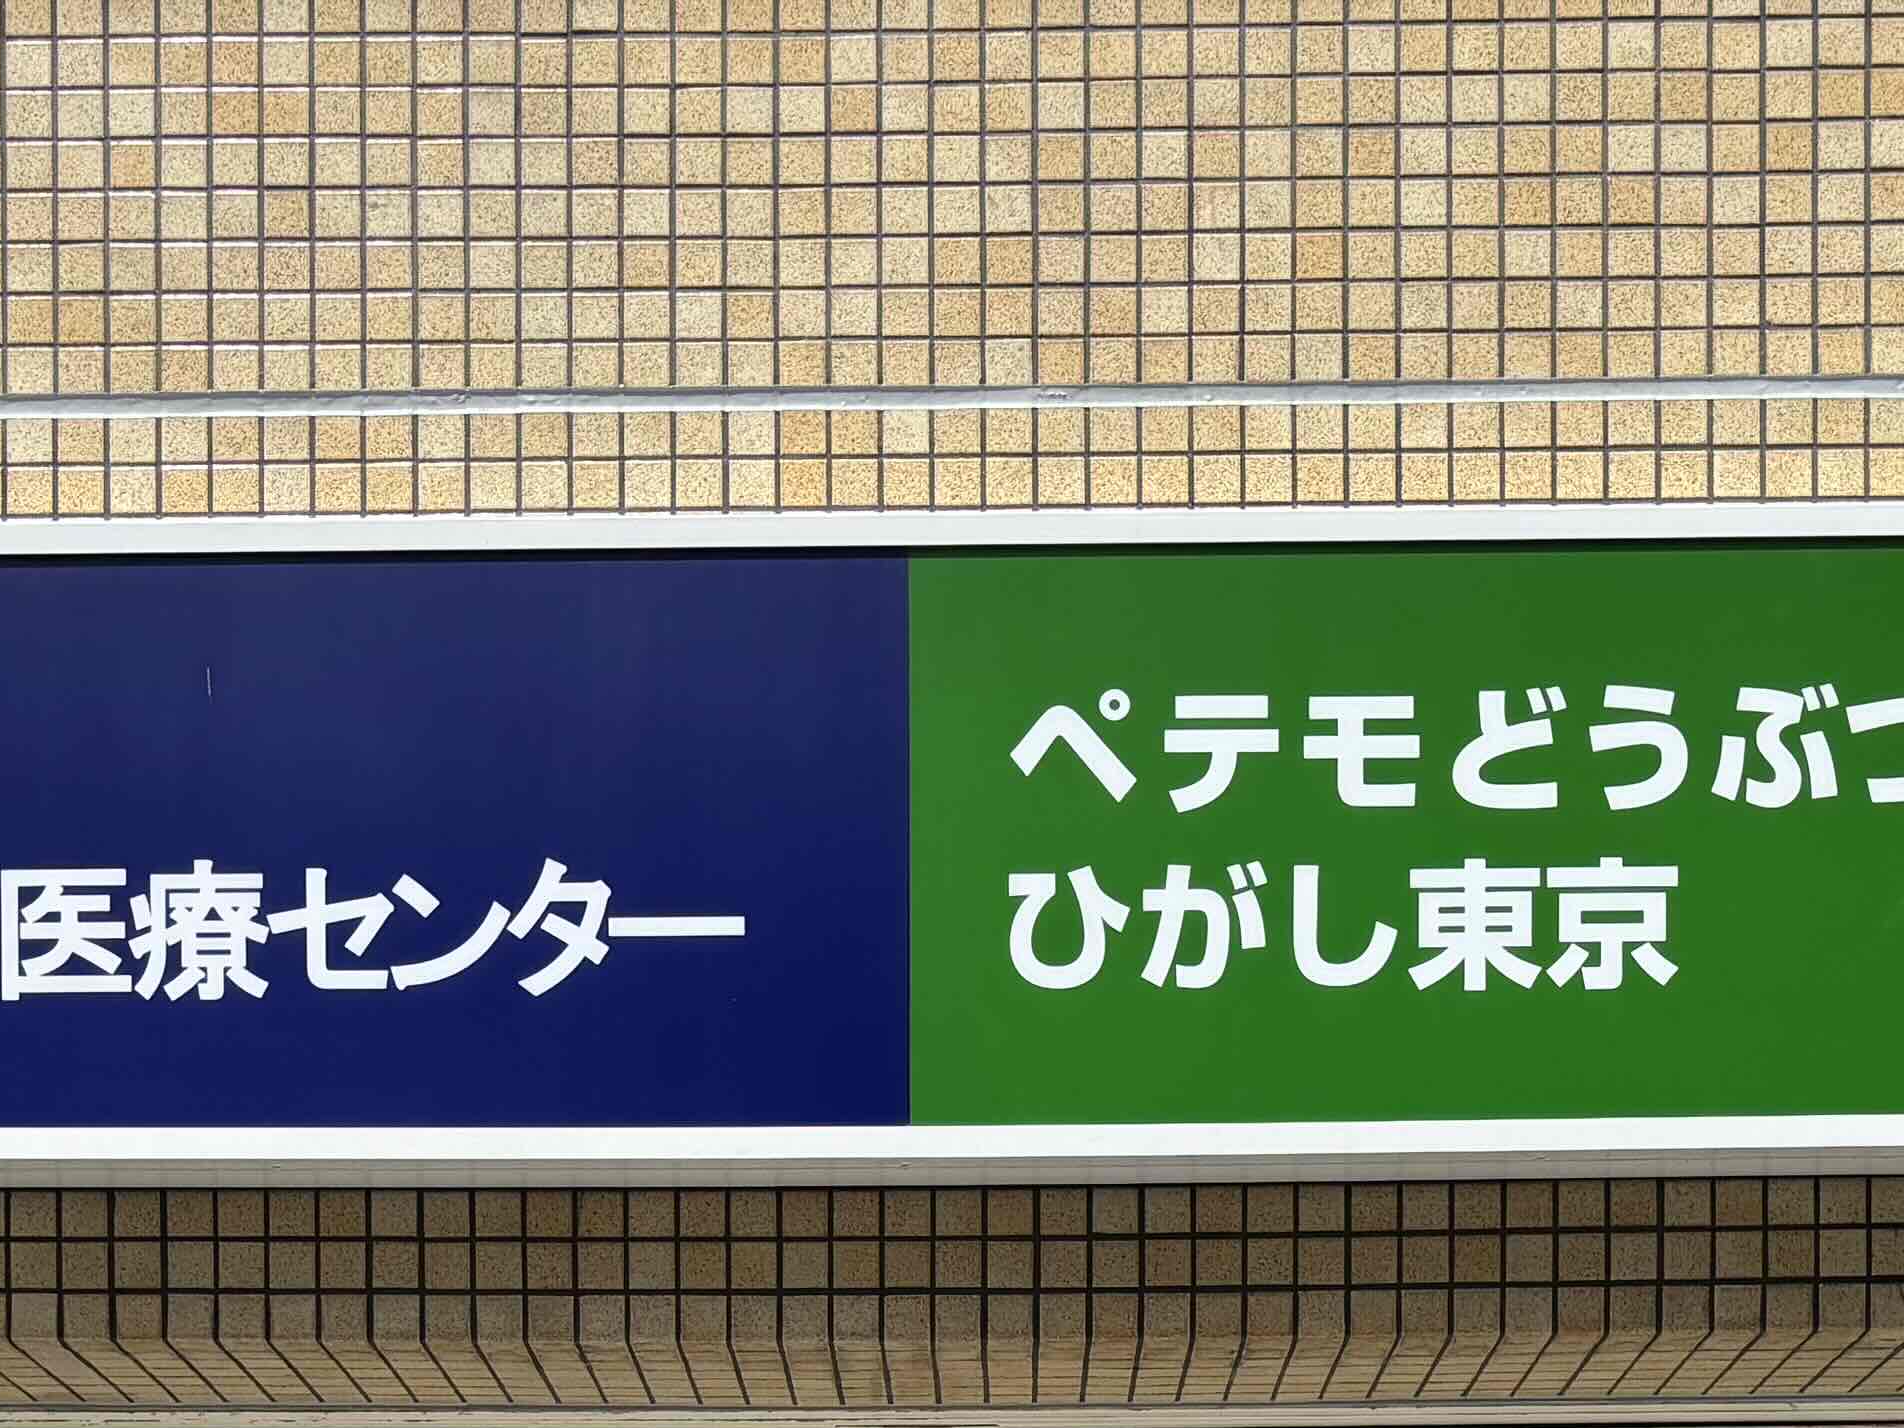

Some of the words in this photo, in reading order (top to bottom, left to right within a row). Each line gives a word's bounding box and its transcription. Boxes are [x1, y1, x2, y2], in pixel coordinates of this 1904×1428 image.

[1006, 852, 1684, 994] ひがし東京
